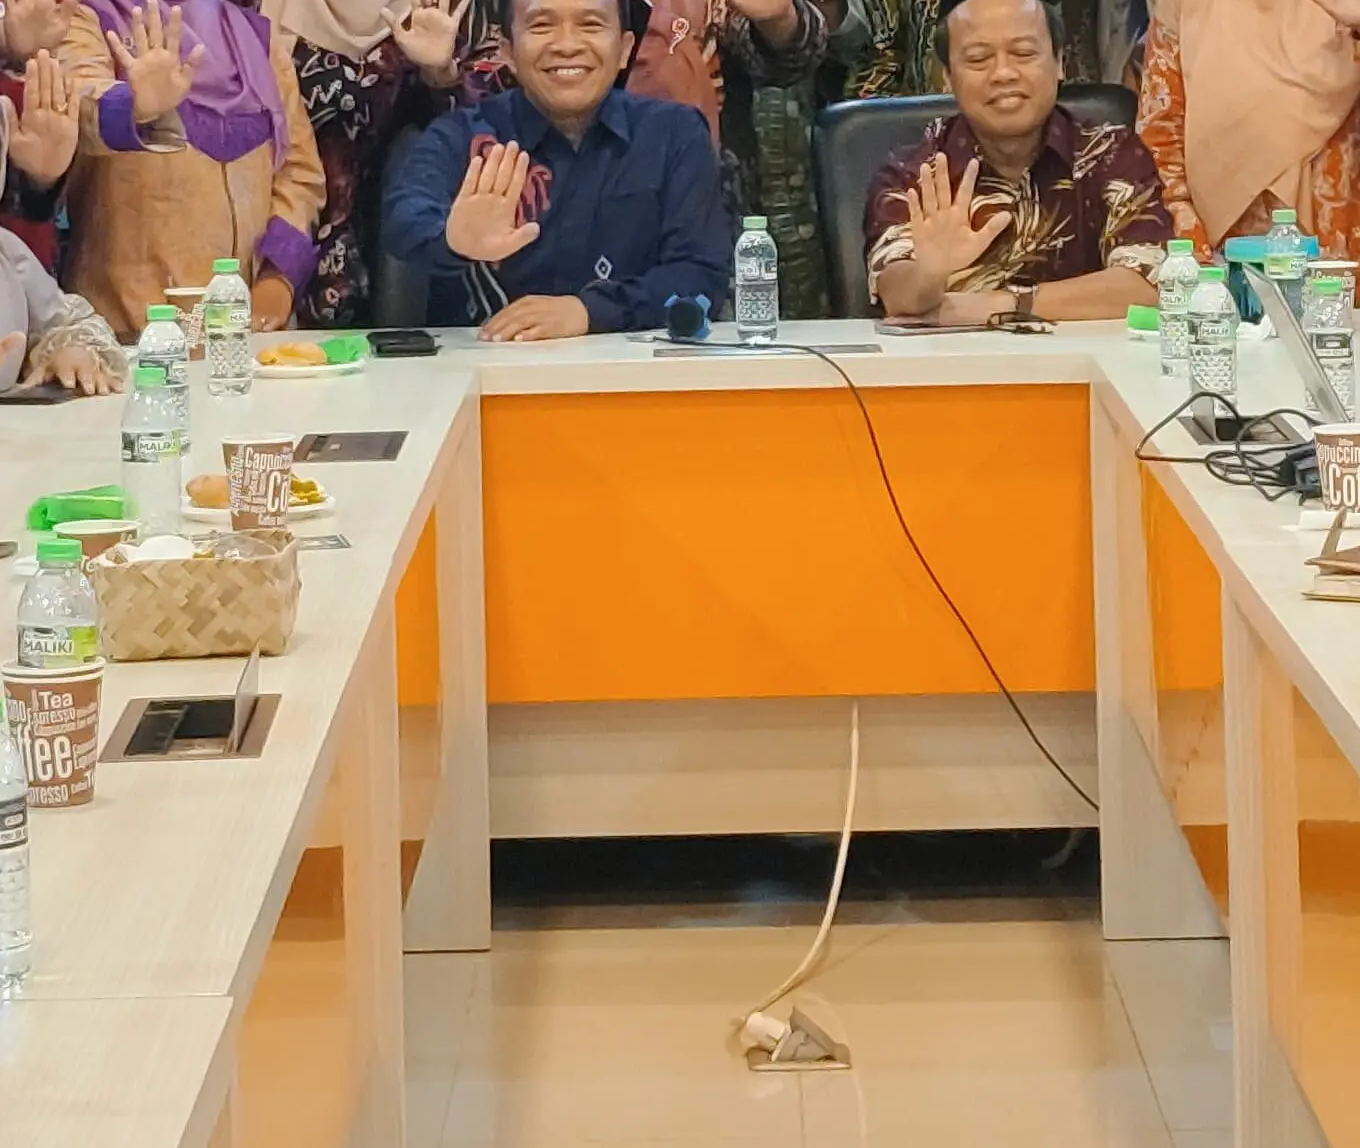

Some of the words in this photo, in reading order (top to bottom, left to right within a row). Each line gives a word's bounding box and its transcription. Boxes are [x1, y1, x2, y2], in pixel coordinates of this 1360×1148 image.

[24, 640, 73, 654] MALIKI
[38, 691, 74, 710] Tea
[14, 723, 73, 782] ffee
